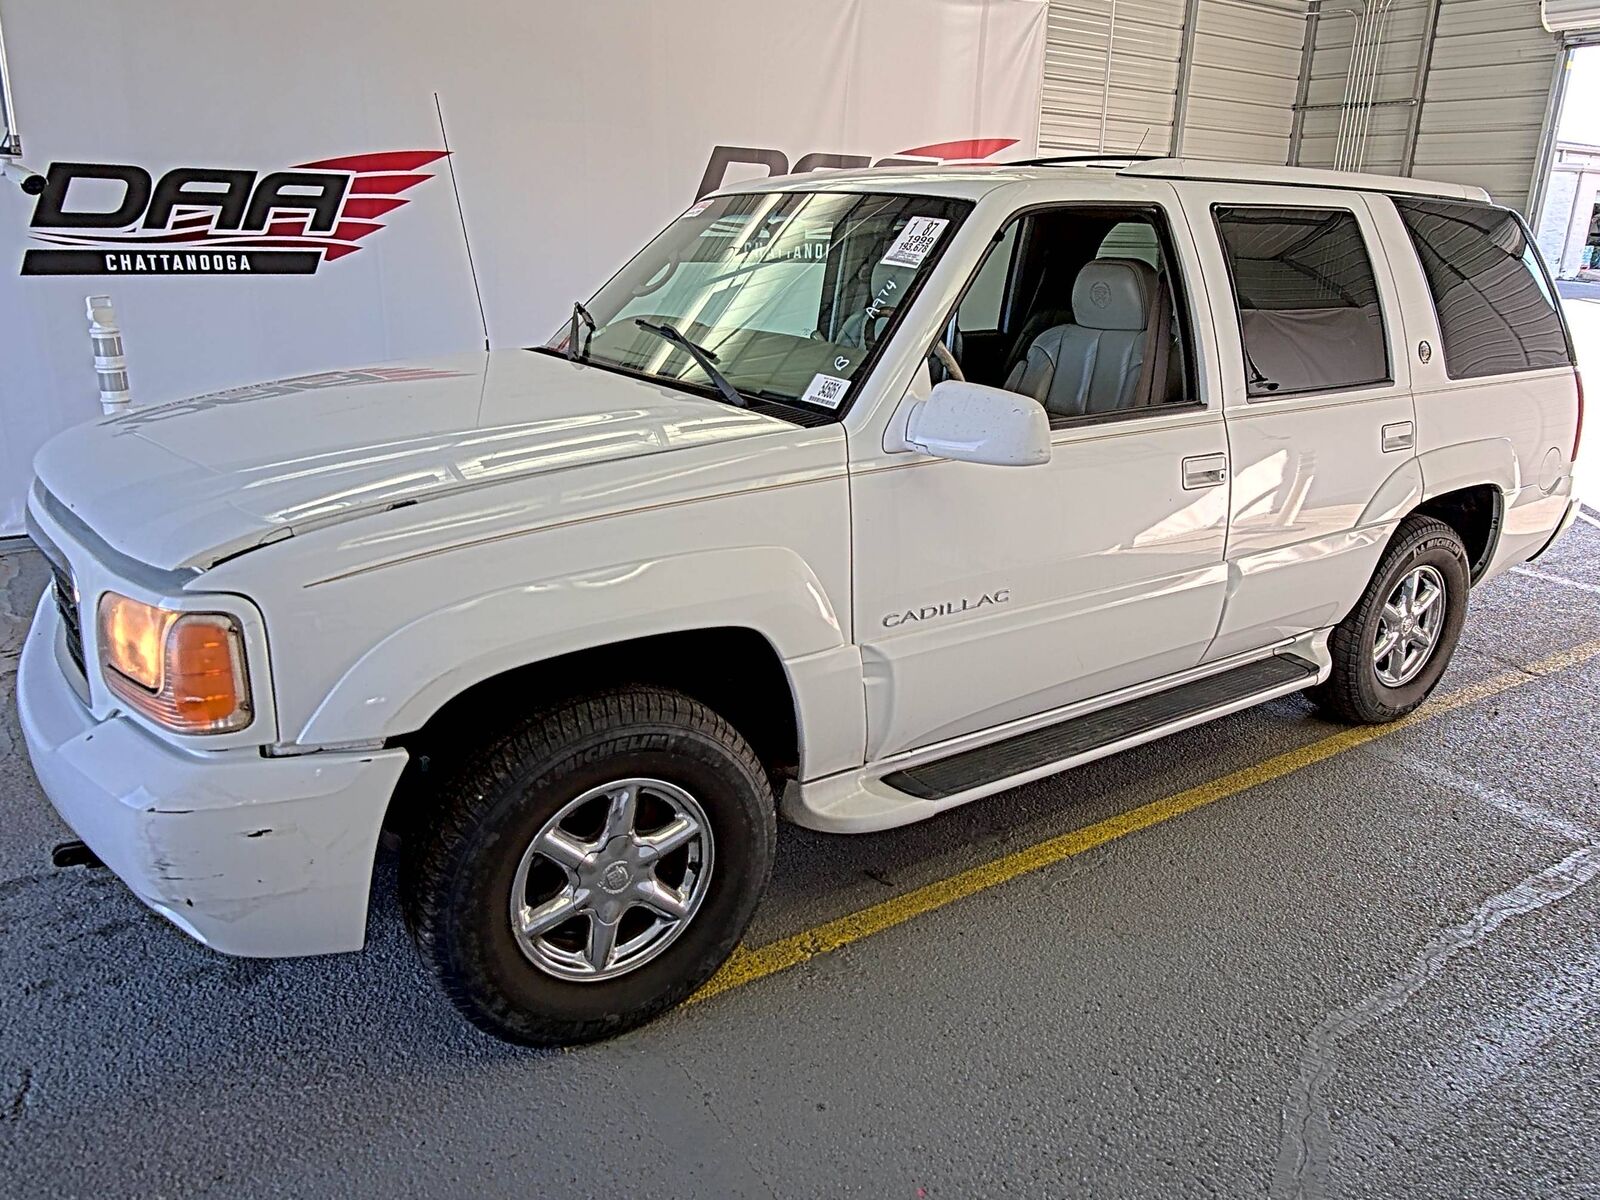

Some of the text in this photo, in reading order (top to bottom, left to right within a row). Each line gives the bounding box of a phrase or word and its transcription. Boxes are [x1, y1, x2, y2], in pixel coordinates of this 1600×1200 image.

[29, 162, 350, 232] DAA
[908, 235, 935, 246] 1999
[106, 253, 251, 271] CHATTANOOGA
[882, 590, 1009, 627] CADILLAC
[555, 734, 669, 773] MICHELIN
